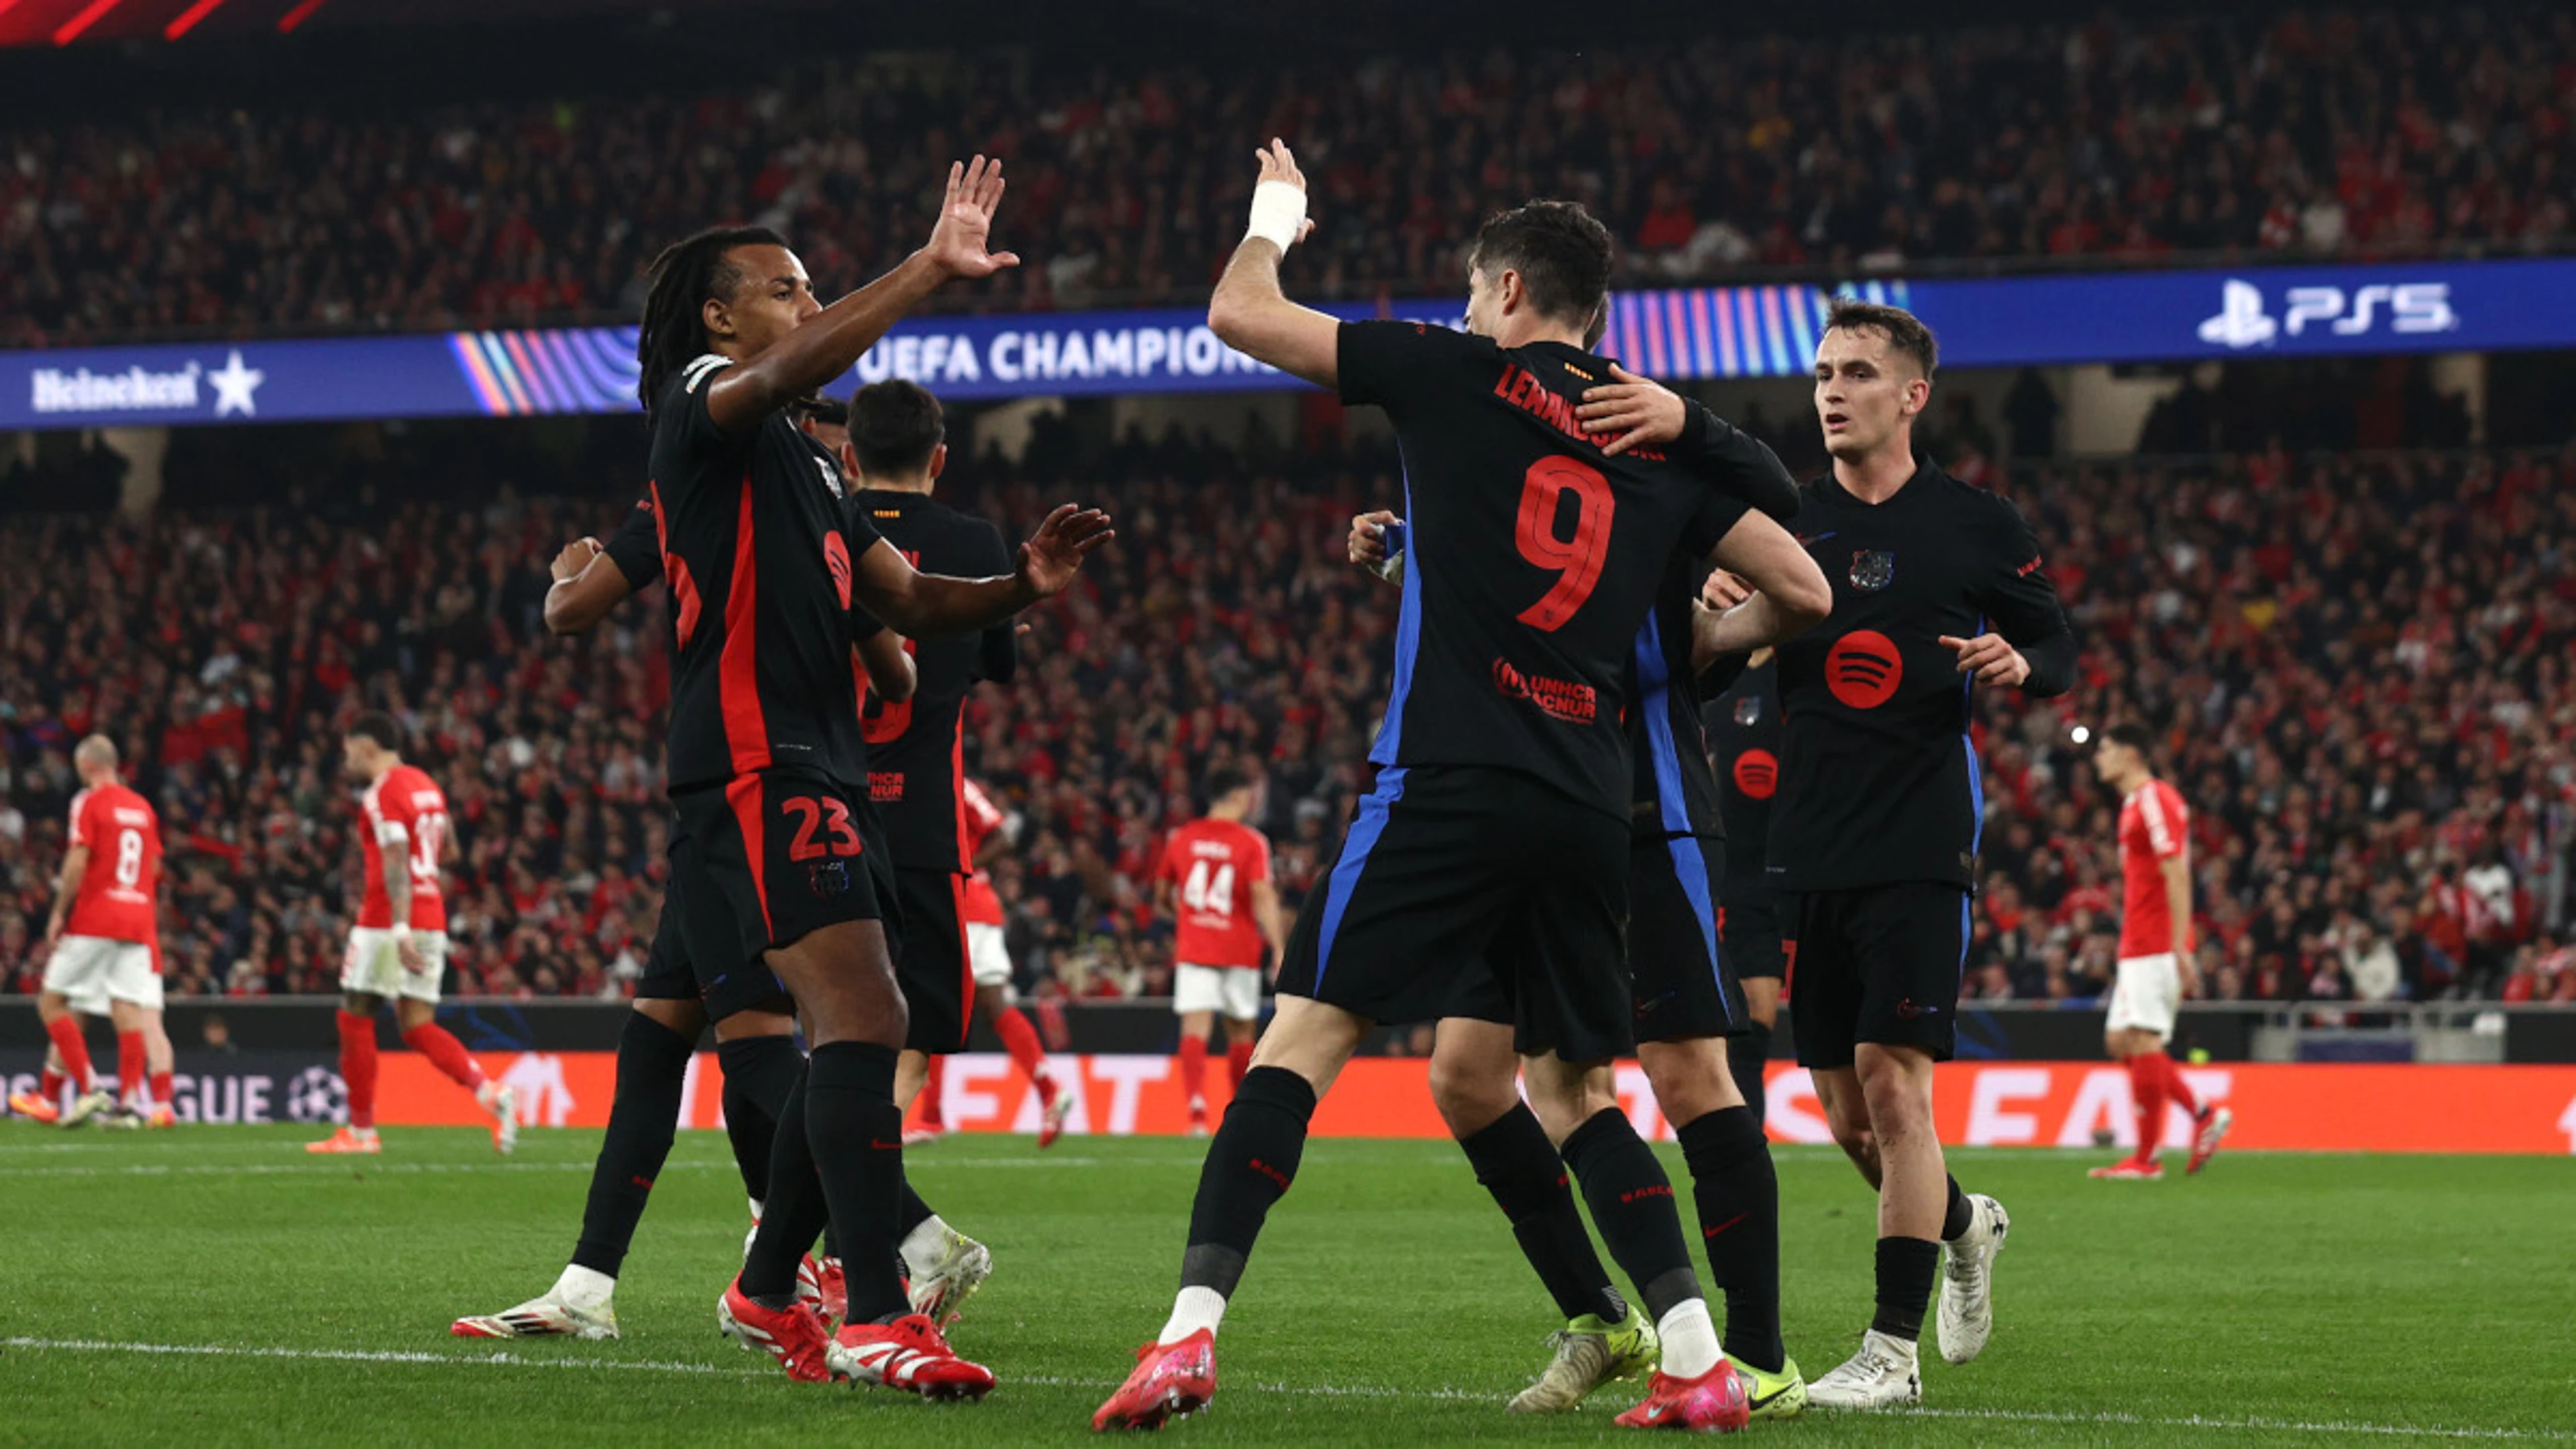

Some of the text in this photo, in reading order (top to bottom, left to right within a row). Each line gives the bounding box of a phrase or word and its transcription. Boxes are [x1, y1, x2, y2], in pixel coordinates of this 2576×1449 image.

[2286, 282, 2451, 335] PS5
[856, 324, 1282, 382] UEFA CHAMPION
[32, 365, 199, 412] Heineken
[1515, 454, 1615, 633] 9
[1530, 675, 1596, 702] UNHCR
[116, 828, 143, 886] 8
[782, 796, 862, 861] 23
[1183, 859, 1234, 915] 44
